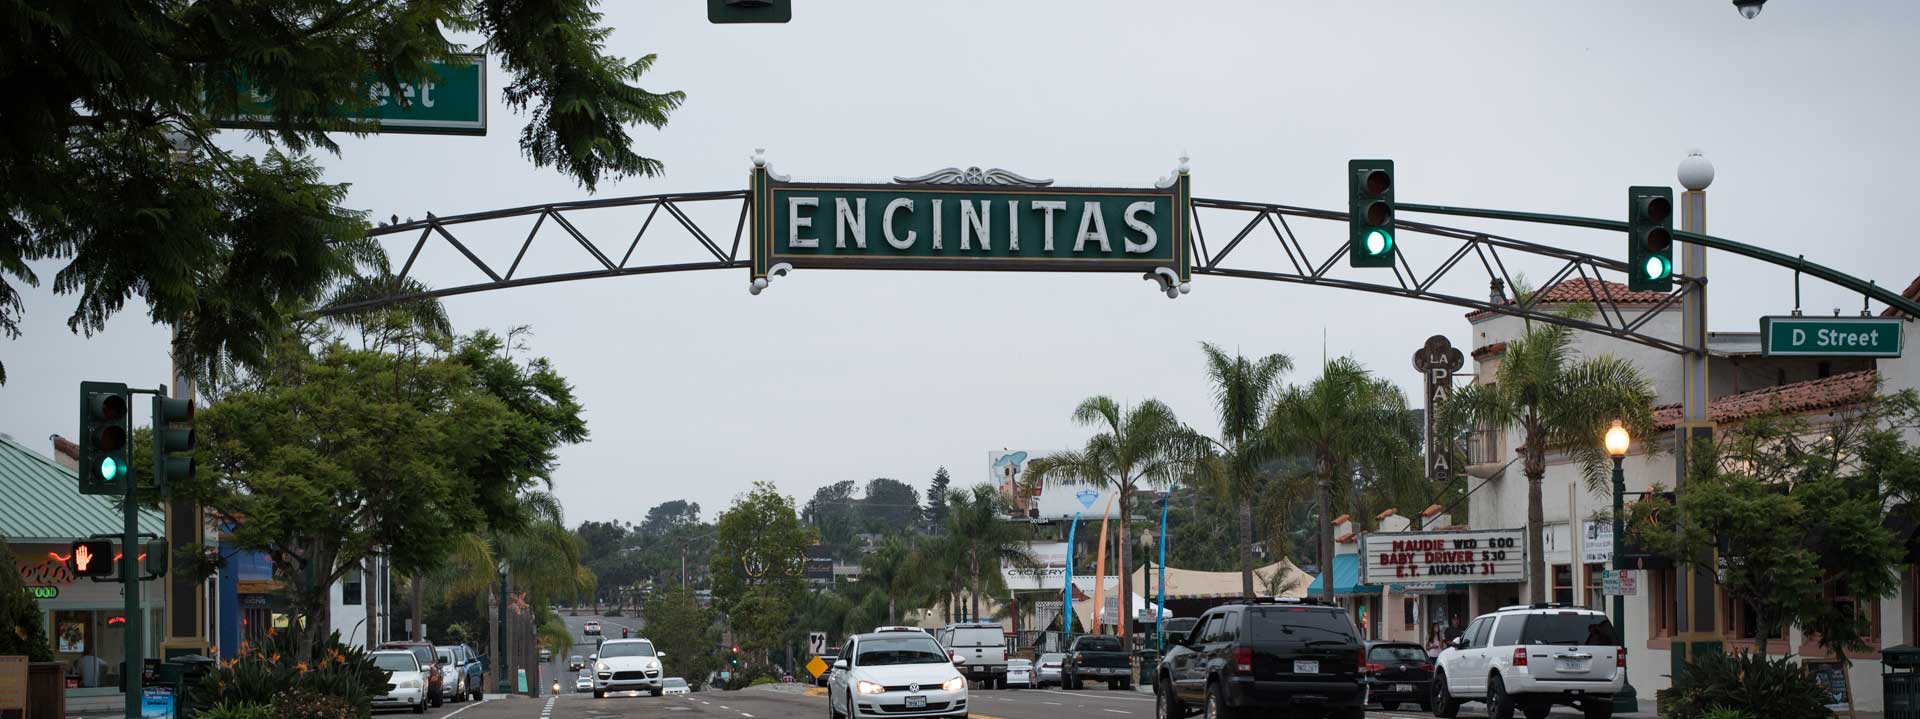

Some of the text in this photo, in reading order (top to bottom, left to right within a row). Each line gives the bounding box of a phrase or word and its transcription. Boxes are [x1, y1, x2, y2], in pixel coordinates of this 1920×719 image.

[788, 196, 1158, 254] ENCINITAS
[1792, 328, 1879, 346] D Street
[1430, 354, 1449, 364] LA
[1392, 538, 1514, 551] MAUDIE WED 600
[1380, 550, 1506, 565] BABY DRIVER 530
[1396, 563, 1495, 578] E.T. AUGUST 31
